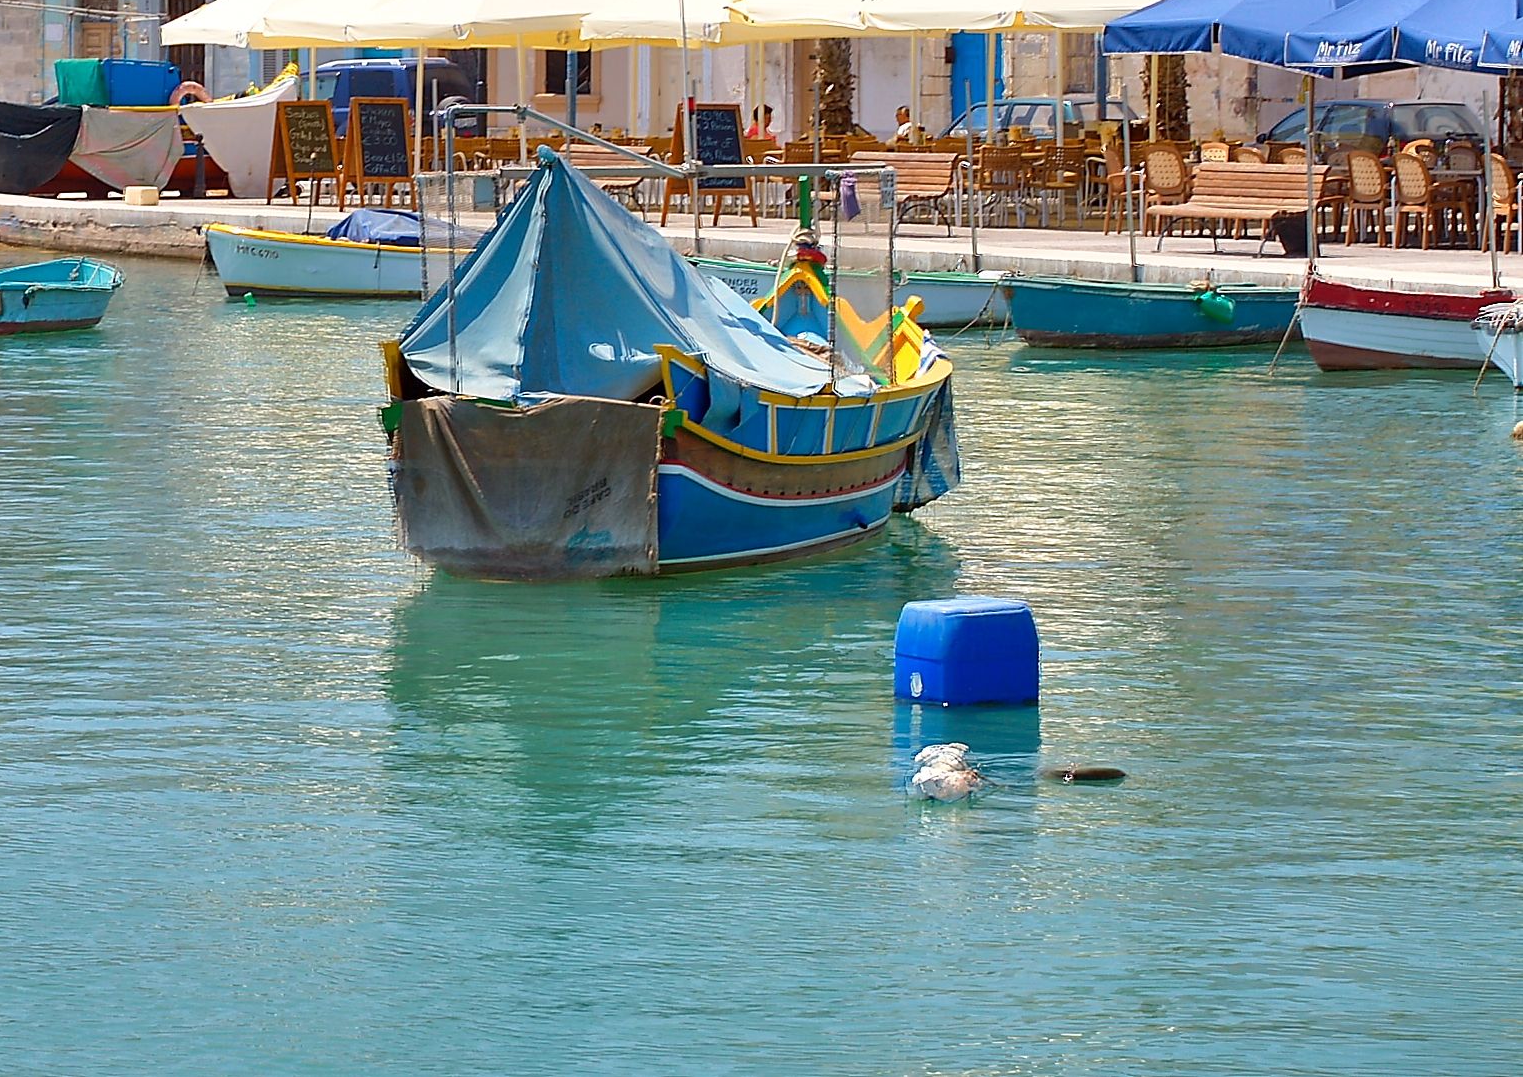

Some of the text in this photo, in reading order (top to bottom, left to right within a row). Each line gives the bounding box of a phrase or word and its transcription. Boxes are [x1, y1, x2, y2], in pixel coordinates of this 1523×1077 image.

[1315, 41, 1335, 57] Mr
[1425, 39, 1443, 59] Mr
[718, 277, 758, 287] ENDER
